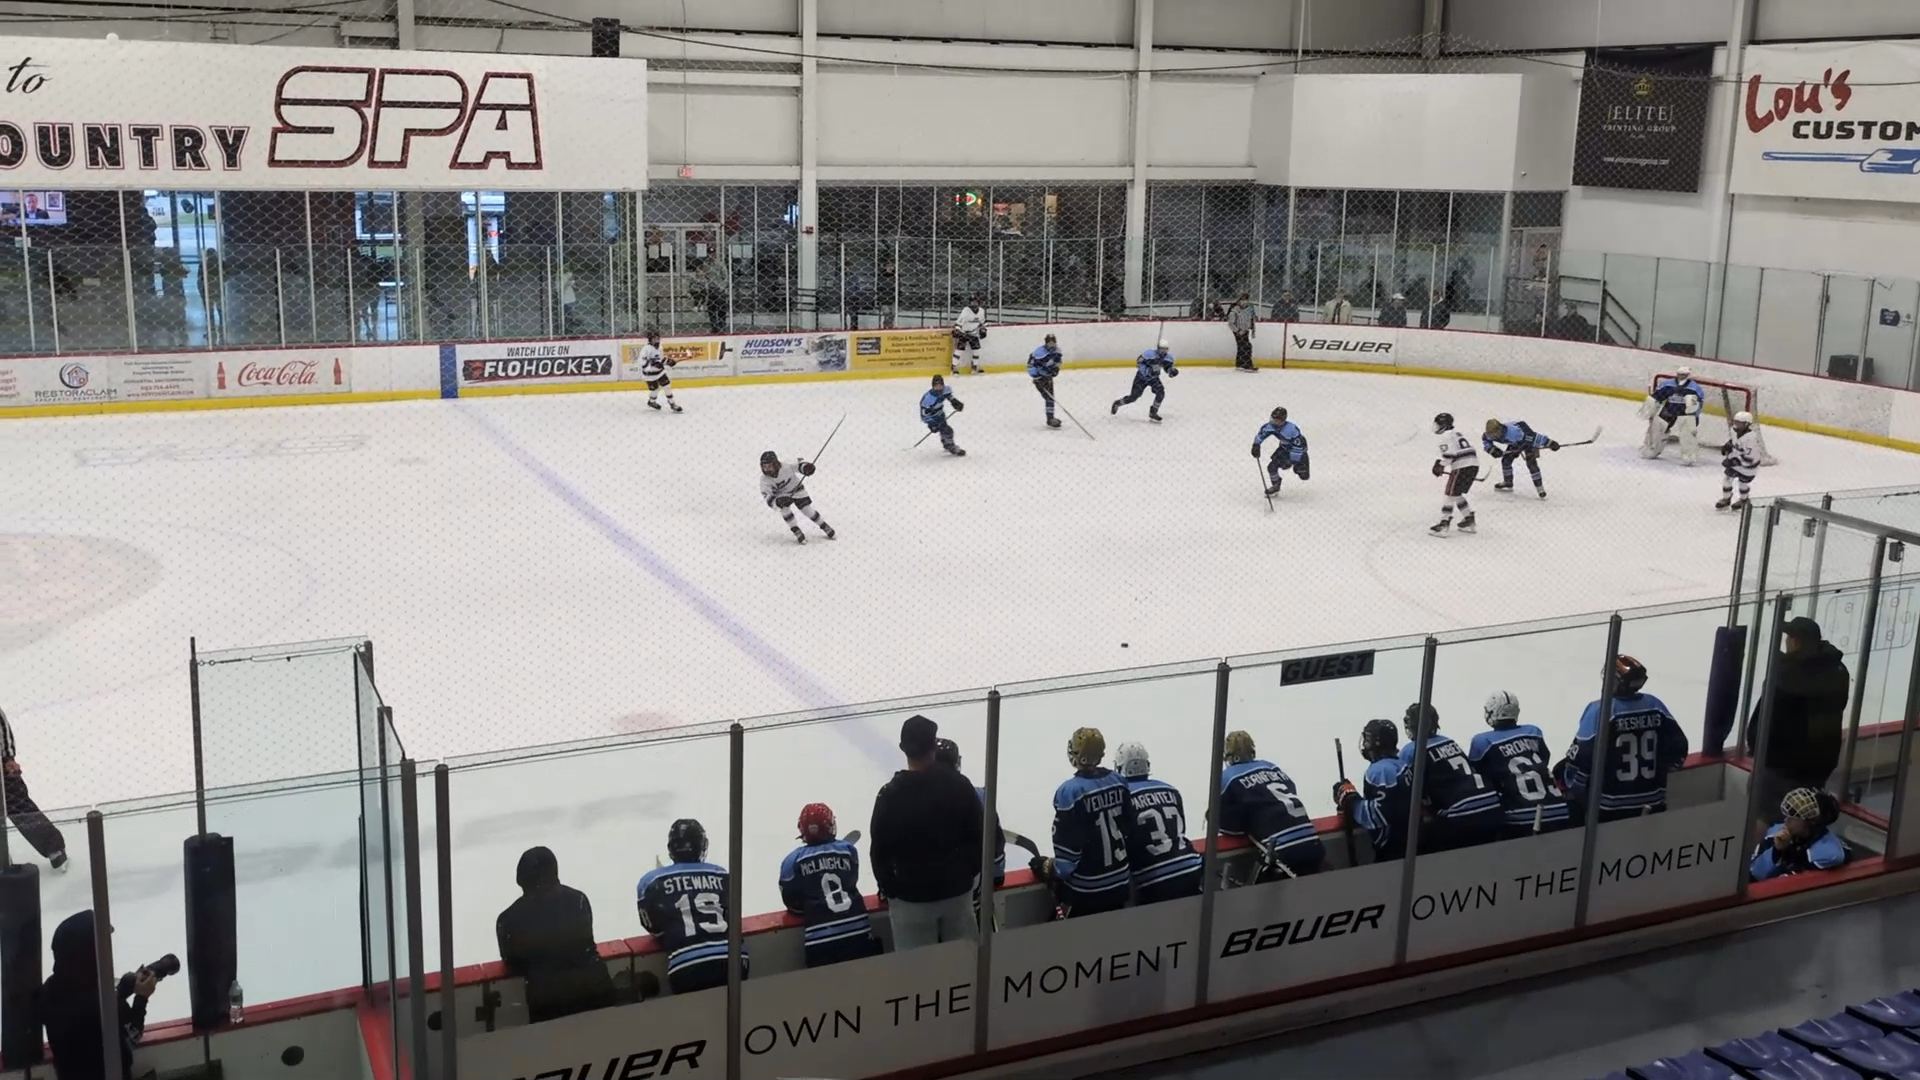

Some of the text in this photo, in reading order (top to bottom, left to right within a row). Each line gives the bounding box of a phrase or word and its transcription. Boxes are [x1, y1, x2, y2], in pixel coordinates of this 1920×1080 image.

[5, 57, 53, 94] to
[267, 65, 543, 171] SPA
[1745, 68, 1852, 133] Lou's
[507, 345, 570, 357] WATCH LIVE ON
[745, 338, 803, 348] HUDSON'S
[238, 360, 319, 387] Coca-Cola
[484, 358, 607, 378] FLOHOCKEY
[1283, 653, 1369, 682] GUEST
[1616, 730, 1658, 782] 39
[1266, 782, 1307, 818] 6
[1095, 806, 1127, 867] 15
[1137, 806, 1187, 856] 37
[663, 875, 724, 894] STEWART
[821, 872, 852, 913] 8
[1411, 836, 1736, 921] OWN THE MOMENT
[675, 892, 729, 937] 19
[744, 941, 1188, 1055] OWN THE MOMENT
